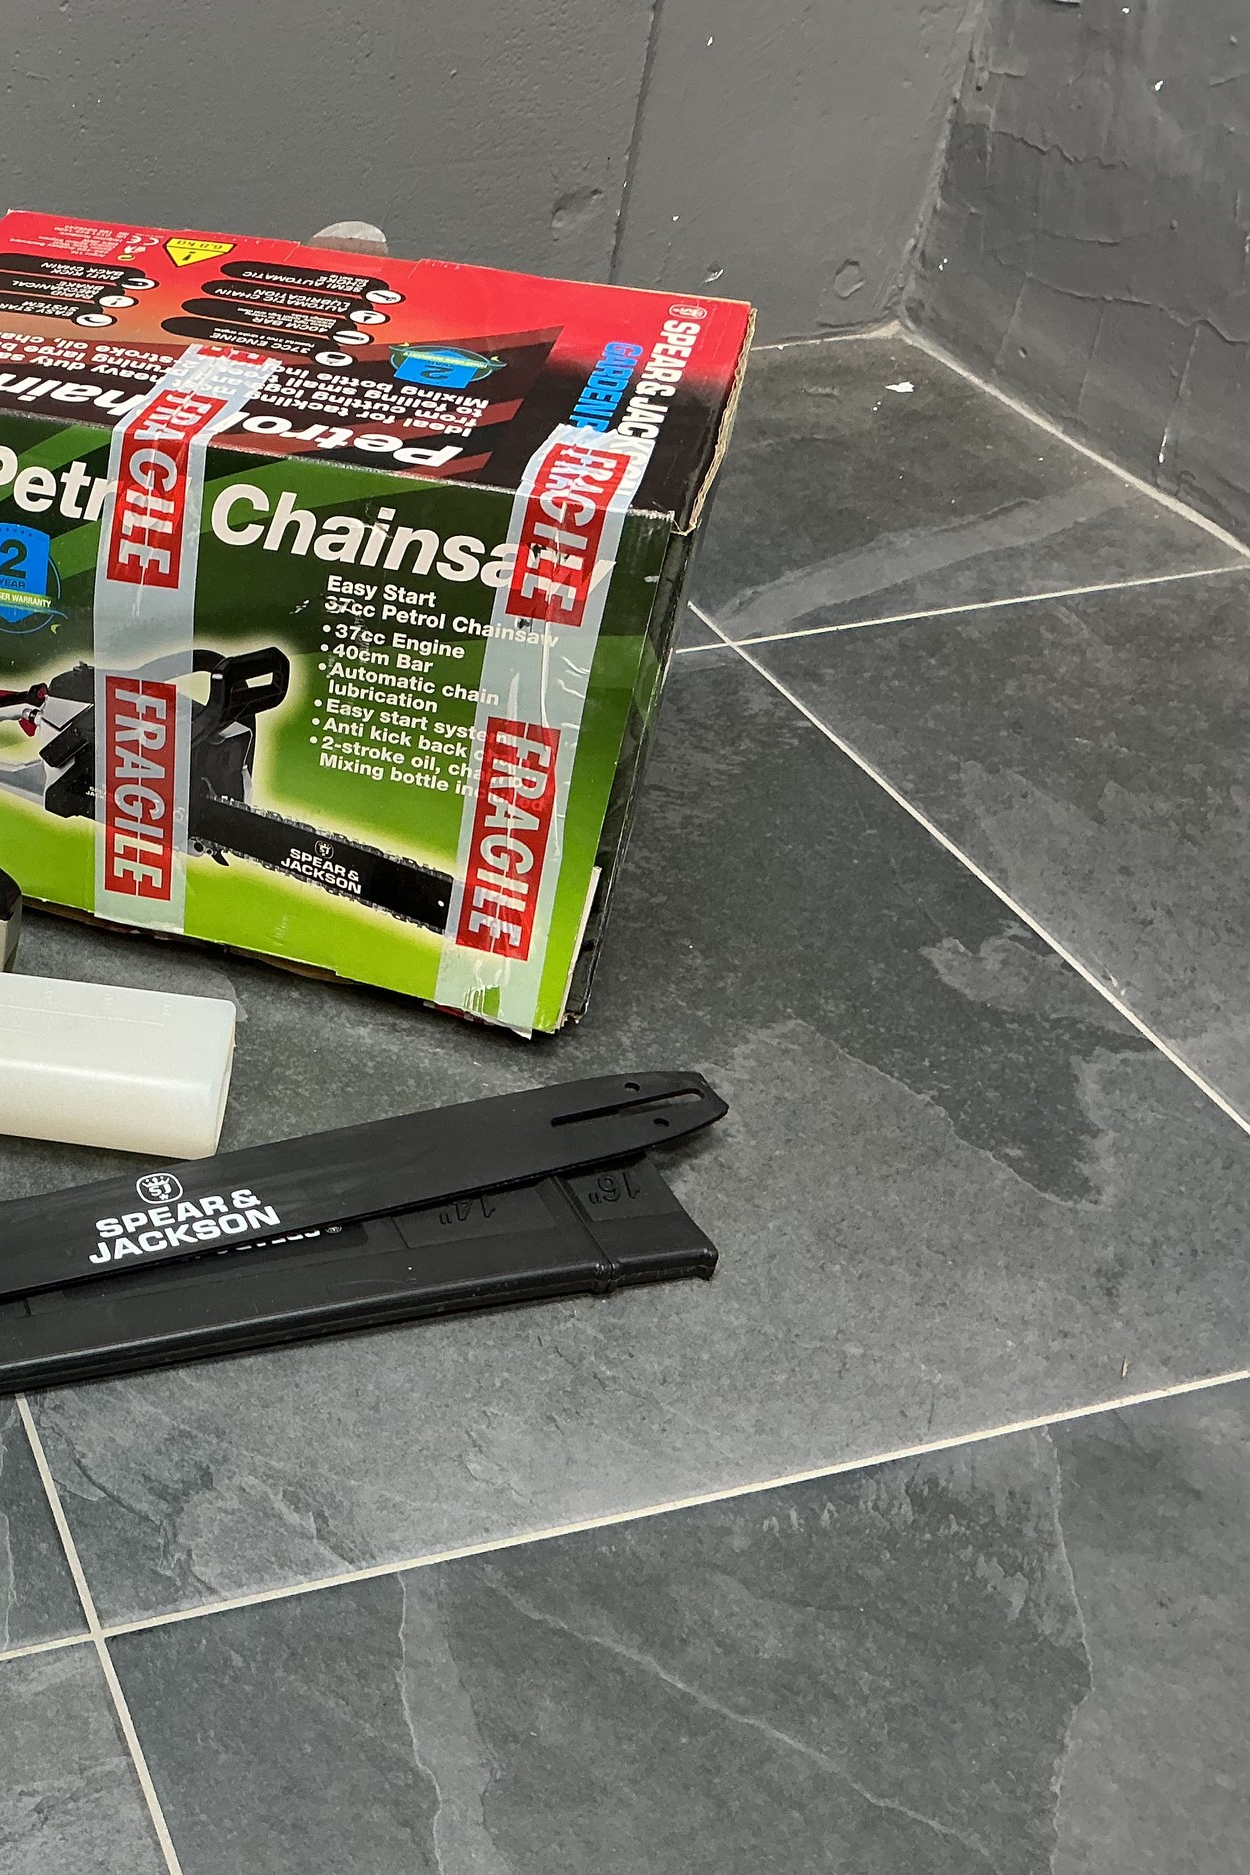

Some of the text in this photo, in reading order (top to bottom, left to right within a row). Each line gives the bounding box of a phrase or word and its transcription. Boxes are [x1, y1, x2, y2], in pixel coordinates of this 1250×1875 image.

[241, 270, 325, 288] AUTOMATIC
[19, 300, 80, 313] SYSTEM
[213, 287, 260, 302] CHAIN
[252, 288, 352, 309] LUBRICATION
[261, 294, 349, 314] AUTOMATIC
[38, 306, 74, 317] EASY
[251, 316, 283, 328] BAR
[23, 343, 87, 362] large
[51, 336, 90, 351] oil,
[209, 332, 268, 348] ENGINE
[640, 319, 701, 383] SPEAR
[28, 354, 86, 371] duty
[89, 364, 166, 385] heavy
[280, 374, 351, 395] small
[316, 371, 395, 394] bottle
[573, 341, 643, 418] GARDEN
[634, 380, 676, 397] &
[247, 390, 351, 418] tackling
[310, 389, 402, 415] cutting
[363, 387, 455, 416] felling
[399, 384, 490, 410] Mixing
[356, 411, 397, 426] for
[414, 408, 478, 429] from
[455, 406, 484, 419] to
[209, 410, 464, 468] Petrol
[402, 419, 473, 438] Ideal
[117, 392, 213, 576] FRAGILE
[520, 449, 618, 612] FRAGILE
[11, 593, 52, 609] WARRANTY
[327, 575, 437, 608] Easy Start
[324, 595, 559, 648] 37cc Petrol Chainsaw
[334, 623, 466, 660] 37cc Engine
[333, 642, 434, 674] 40cm Bar
[328, 679, 438, 714] lubrication
[329, 661, 499, 706] Automatic chain
[326, 699, 374, 726] Easy
[379, 710, 428, 731] start
[323, 717, 364, 738] Anti
[370, 726, 412, 748] kick
[418, 735, 468, 759] back
[321, 735, 405, 764] 2-stroke
[411, 755, 441, 775] oil,
[319, 752, 384, 781] Mixing
[390, 767, 449, 793] bottle
[113, 687, 171, 899] FRAGILE
[468, 732, 552, 947] FRAGILE
[280, 857, 363, 896] JACKSON
[290, 848, 359, 882] SPEAR &
[95, 1188, 262, 1239] SPEAR &
[88, 1205, 282, 1265] JACKSON
